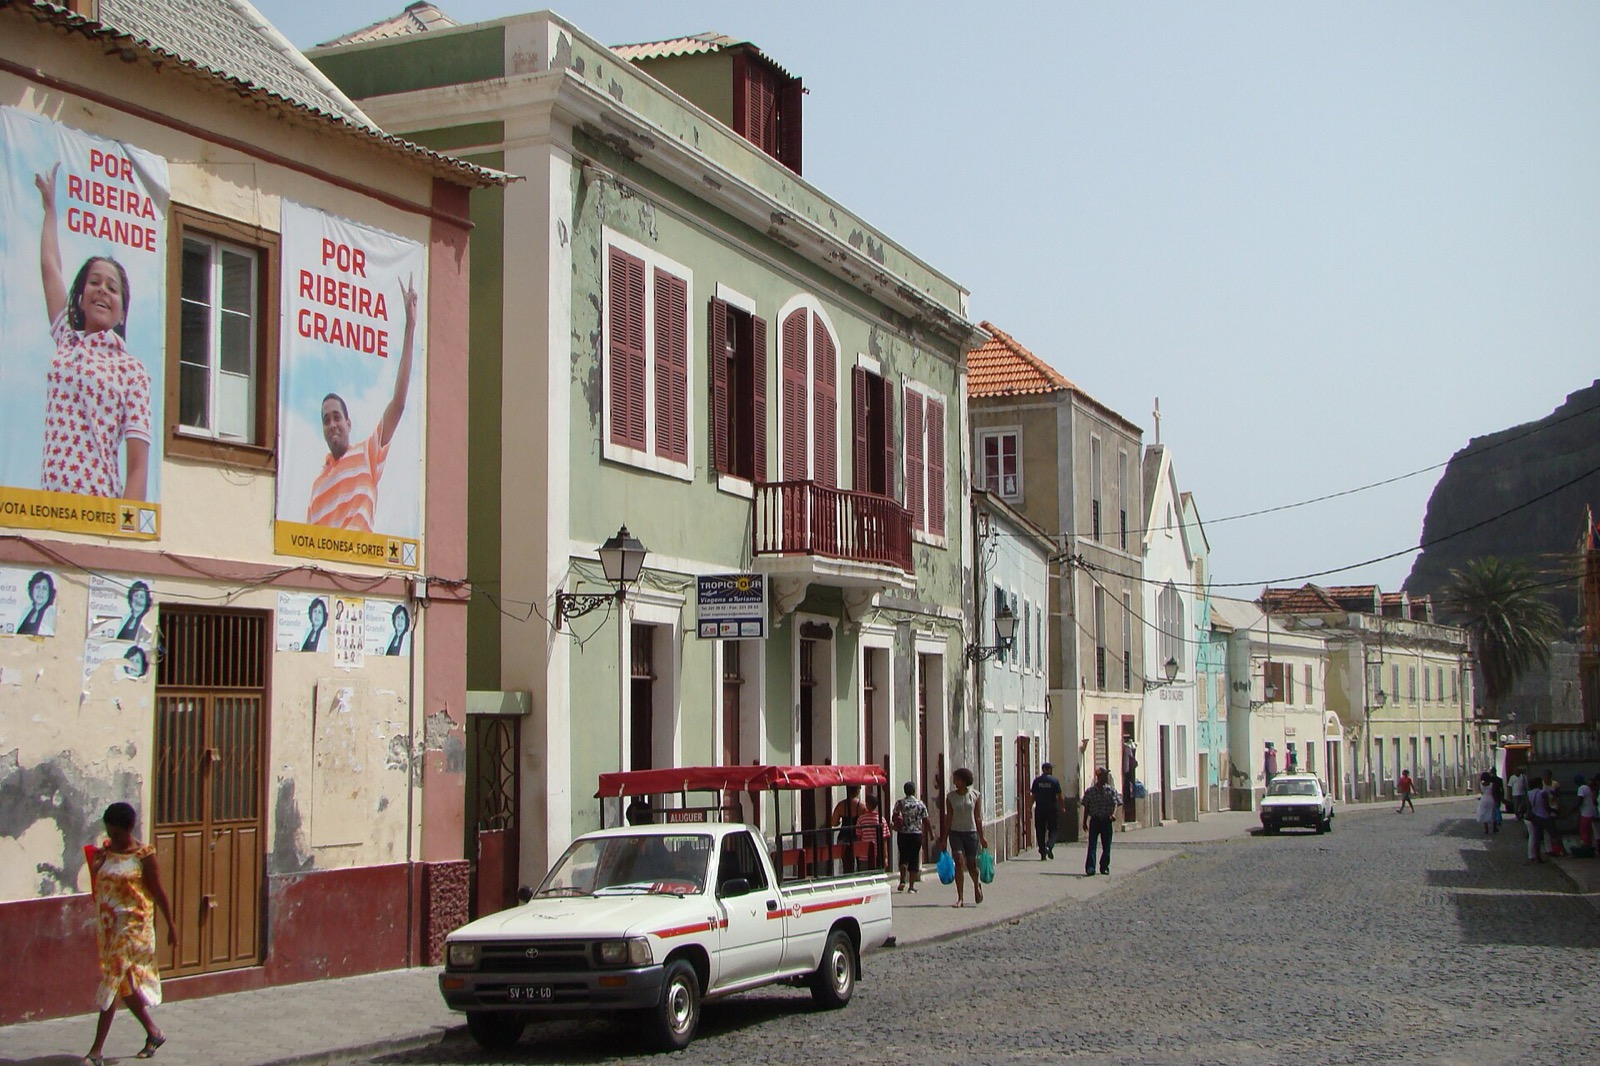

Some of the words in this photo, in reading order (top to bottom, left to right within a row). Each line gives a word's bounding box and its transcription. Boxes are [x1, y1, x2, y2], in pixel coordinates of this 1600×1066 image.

[91, 149, 135, 184] POR
[69, 174, 156, 221] RIBEIRA
[67, 207, 156, 253] GRANDE
[322, 238, 366, 278] POR
[299, 269, 388, 322] RIBEIRA
[298, 308, 388, 358] GRANDE
[31, 504, 78, 520] LEONESA
[81, 510, 117, 524] FORTES
[291, 534, 316, 549] VOTA
[317, 540, 354, 552] LEONESA
[356, 543, 384, 557] FORTES
[92, 577, 105, 586] Por
[91, 588, 118, 600] Ribeira
[90, 602, 118, 611] Grande
[87, 643, 100, 652] Por
[670, 812, 703, 823] ALUGUER
